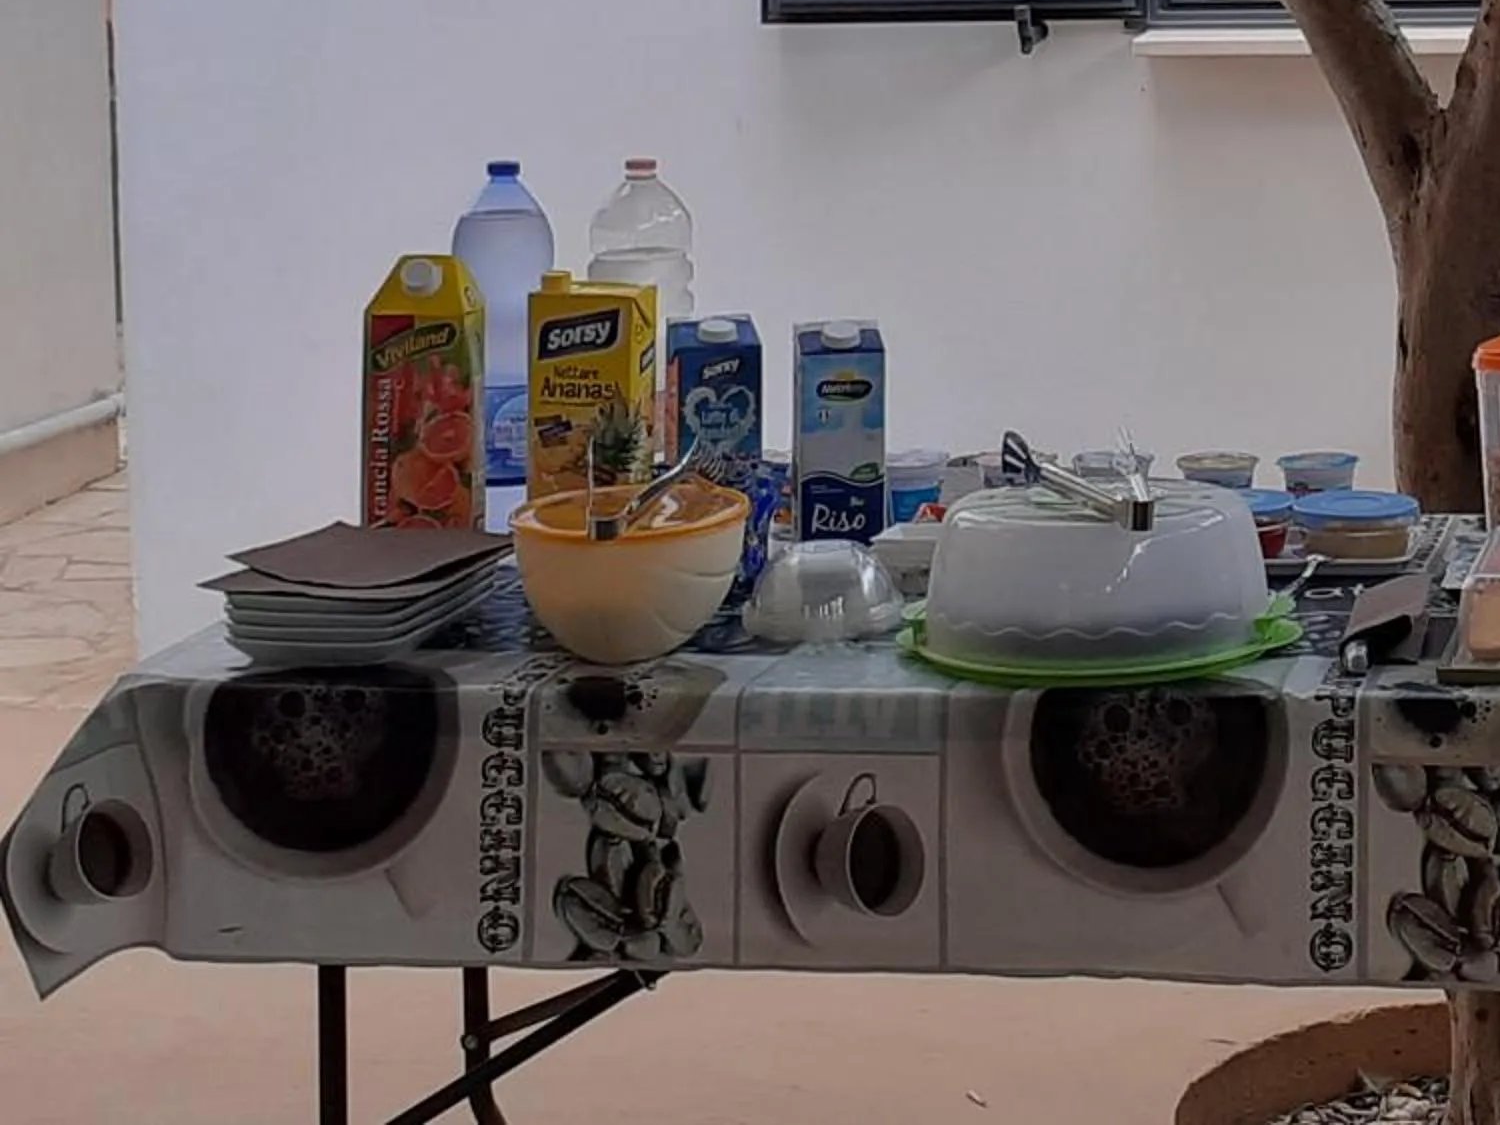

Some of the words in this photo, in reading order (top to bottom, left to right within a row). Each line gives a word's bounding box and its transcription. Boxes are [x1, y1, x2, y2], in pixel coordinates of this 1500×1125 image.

[375, 327, 450, 369] Viviland
[546, 321, 612, 351] Sorsy
[540, 375, 615, 400] Ananas
[370, 378, 391, 443] Rossa
[811, 502, 867, 535] Riso
